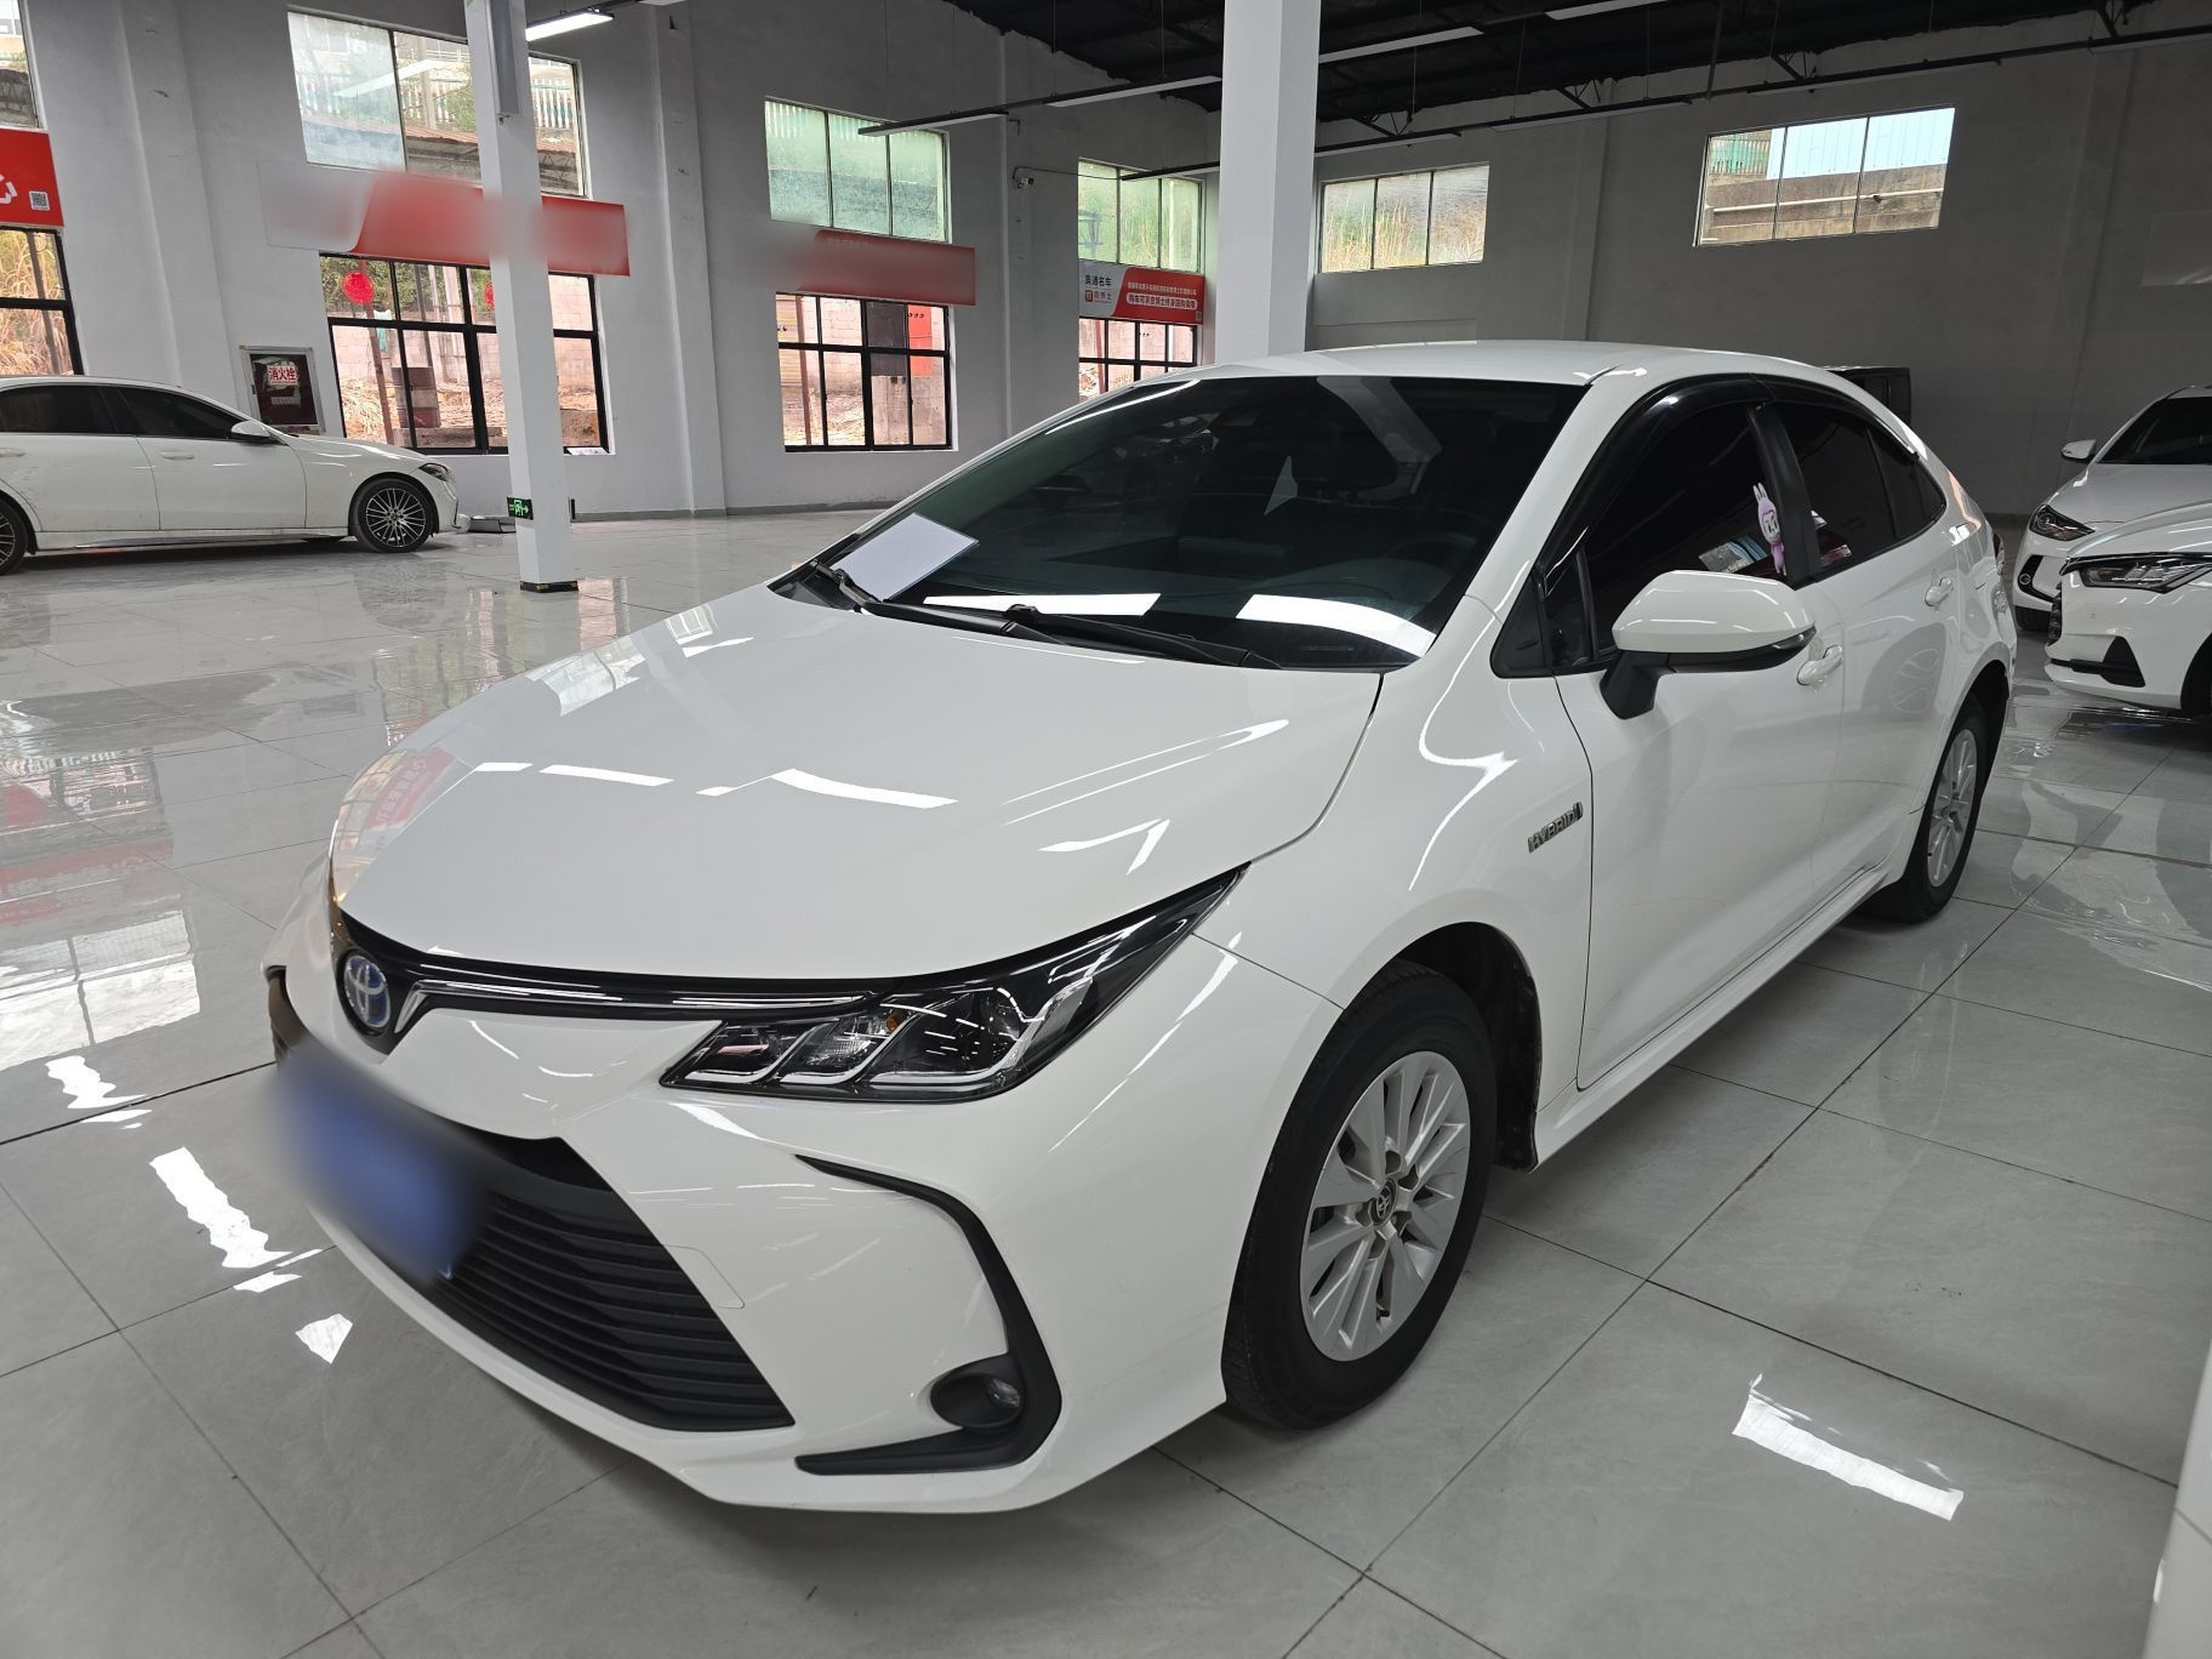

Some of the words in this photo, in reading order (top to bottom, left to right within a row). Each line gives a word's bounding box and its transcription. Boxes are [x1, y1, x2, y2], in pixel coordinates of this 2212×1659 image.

[268, 367, 296, 381] 消火栓
[1528, 807, 1578, 854] HYBRID
